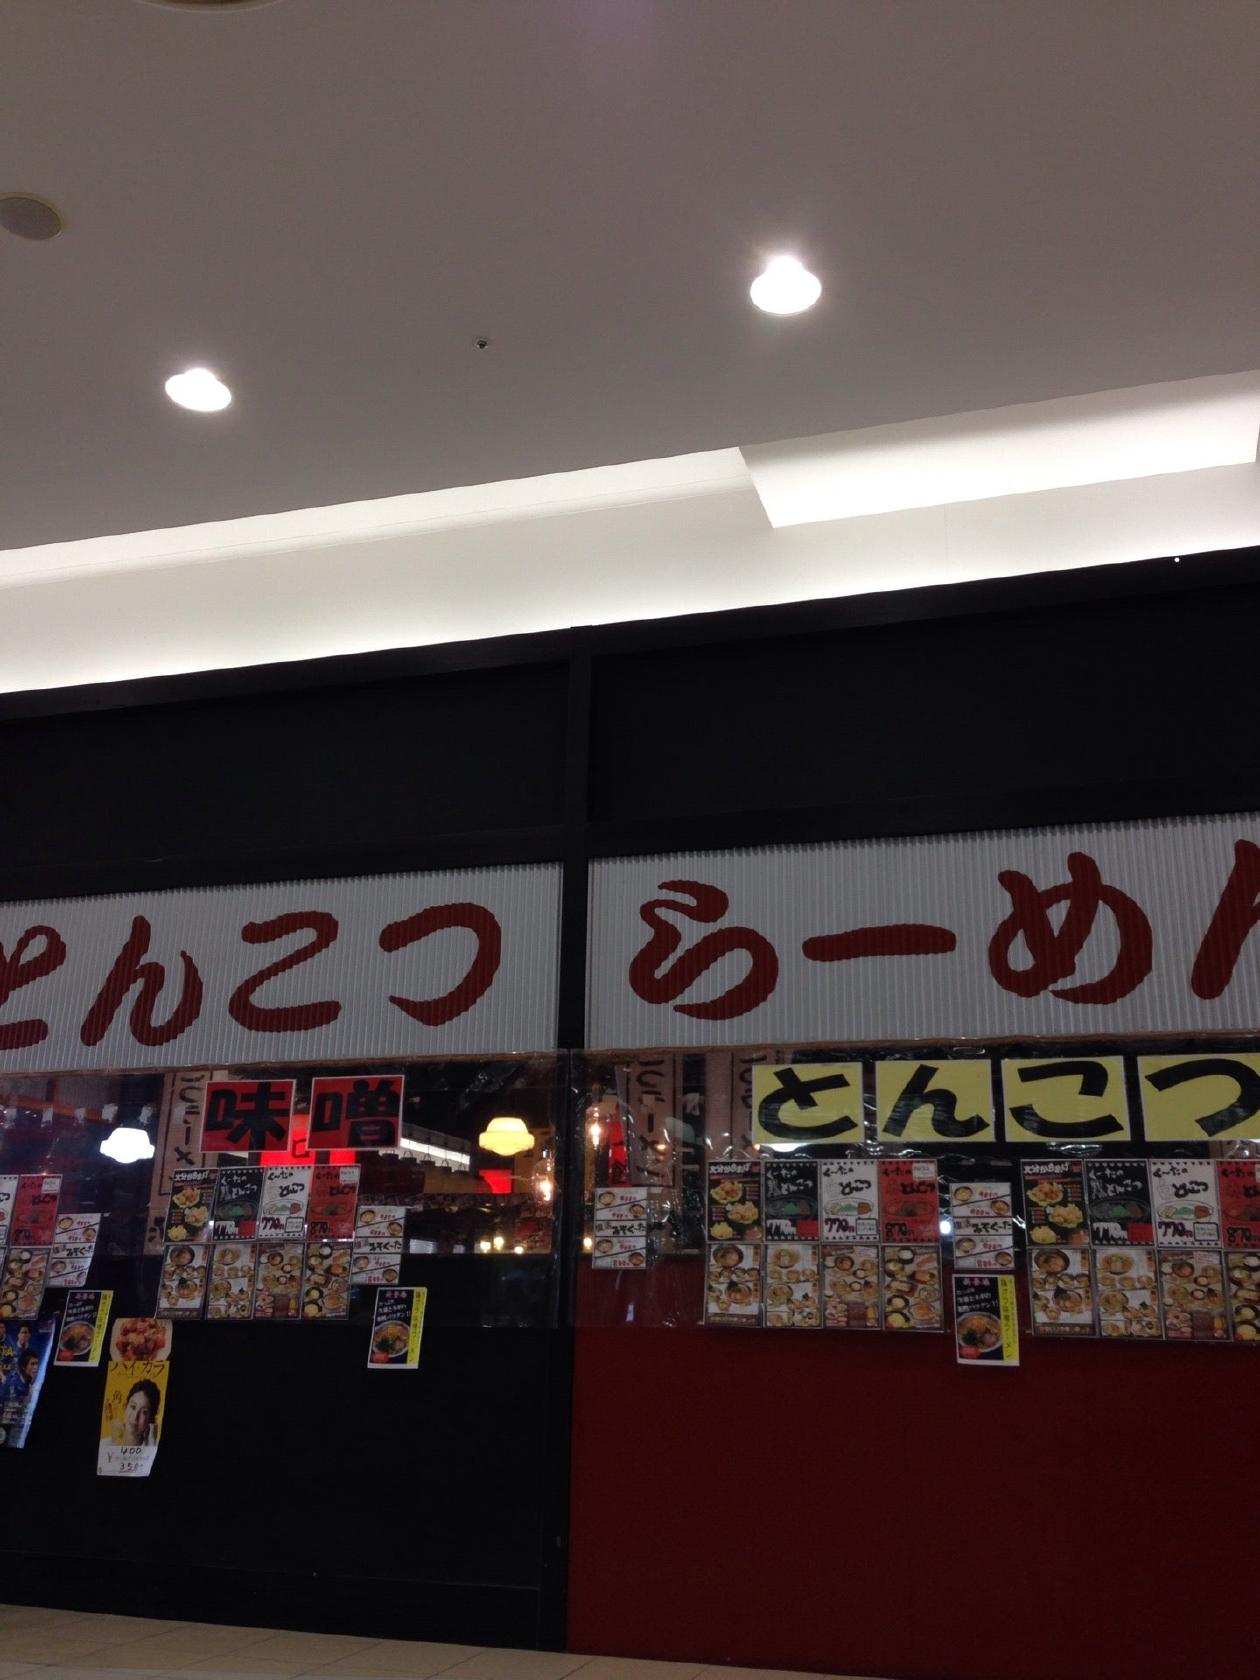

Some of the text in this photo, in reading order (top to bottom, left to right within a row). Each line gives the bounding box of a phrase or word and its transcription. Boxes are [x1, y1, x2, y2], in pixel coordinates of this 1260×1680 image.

[206, 1080, 400, 1151] 味噌
[758, 1058, 1260, 1139] とんこつ
